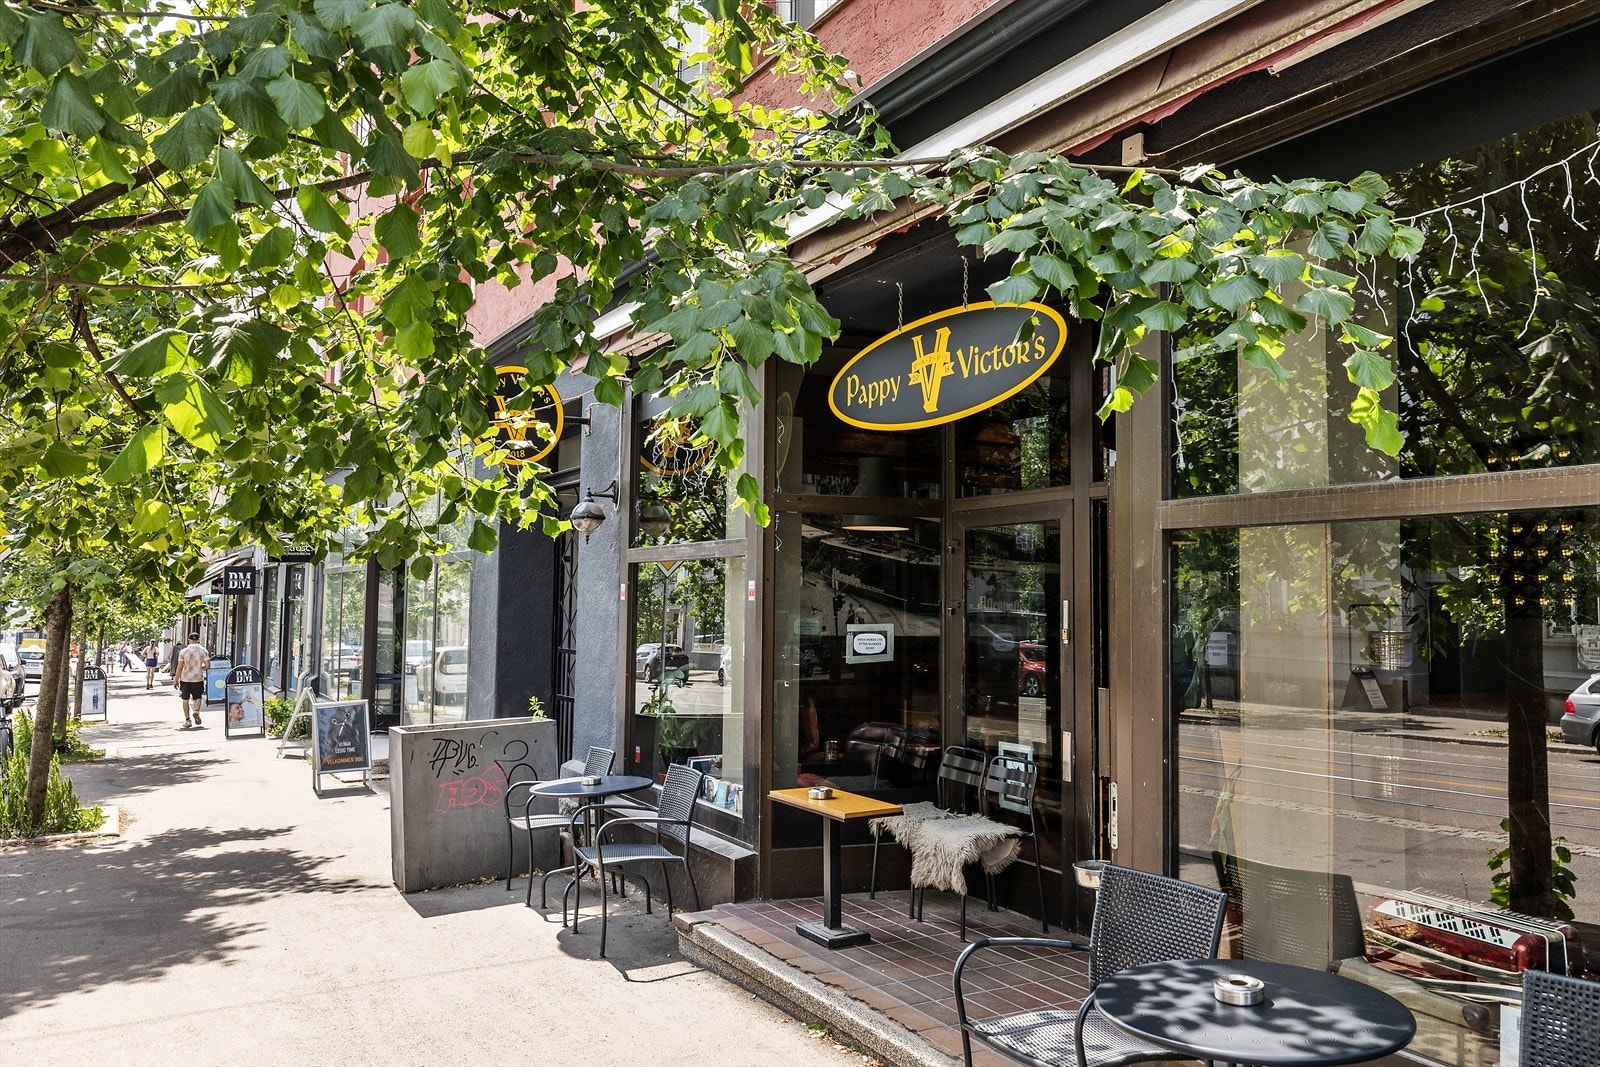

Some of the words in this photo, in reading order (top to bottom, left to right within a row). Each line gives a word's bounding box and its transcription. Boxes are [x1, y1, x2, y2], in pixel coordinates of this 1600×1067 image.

[846, 374, 901, 408] Pappy
[228, 572, 252, 589] BM
[83, 669, 99, 680] BM
[235, 669, 254, 683] BM
[326, 757, 355, 765] VELKOMMEN
